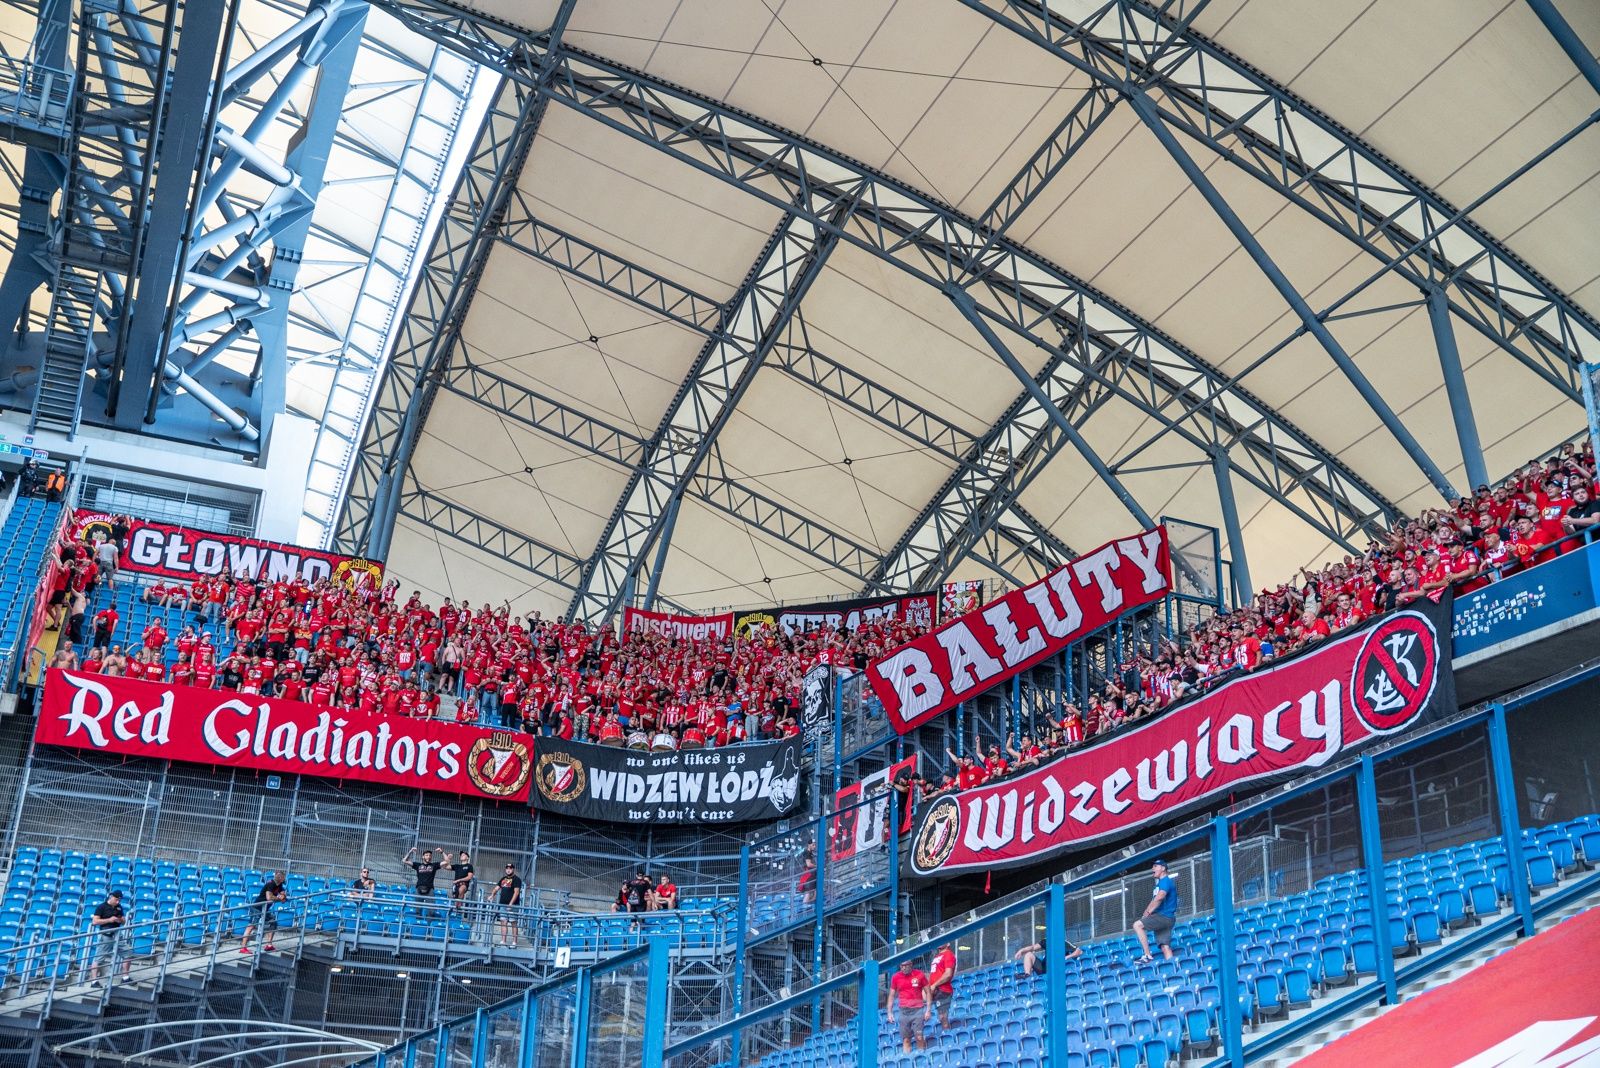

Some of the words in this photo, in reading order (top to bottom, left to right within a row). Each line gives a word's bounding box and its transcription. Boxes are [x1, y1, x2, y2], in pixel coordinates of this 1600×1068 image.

[131, 528, 331, 590] GŁOWNO
[878, 530, 1168, 723] BAŁUTY
[58, 670, 174, 747] Red
[203, 699, 462, 779] Gladiators
[492, 732, 512, 747] 1910
[626, 757, 645, 767] no
[652, 755, 679, 767] one
[684, 753, 721, 765] likes
[727, 752, 746, 764] us
[964, 679, 1342, 851] Widzewiacy
[590, 767, 704, 803] WIDZEW
[707, 761, 774, 803] ŁÓDŹ
[628, 808, 651, 820] we
[701, 809, 734, 820] care
[560, 951, 567, 965] 1
